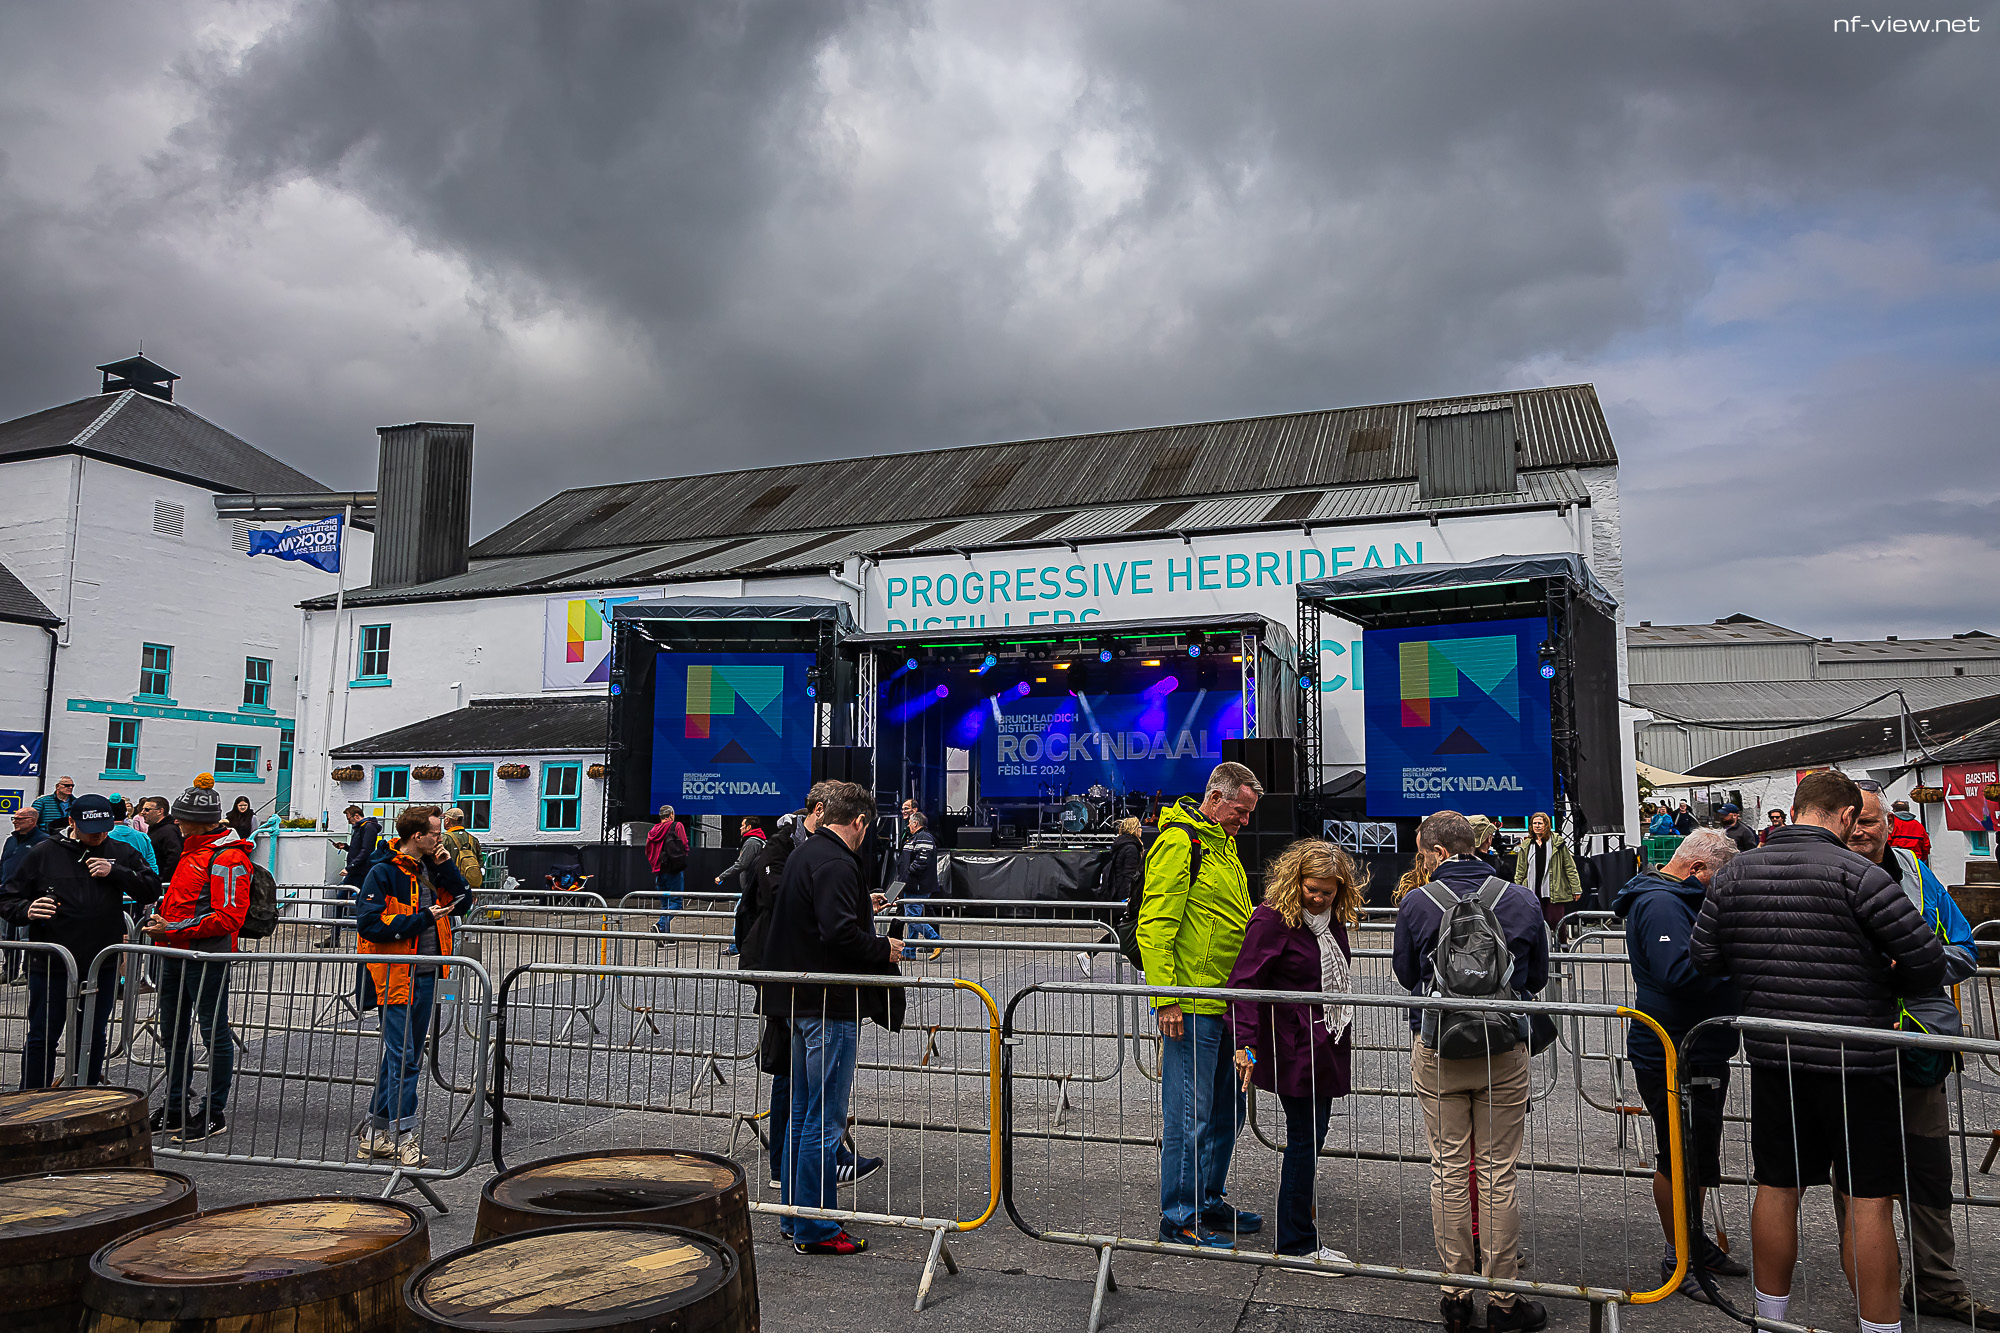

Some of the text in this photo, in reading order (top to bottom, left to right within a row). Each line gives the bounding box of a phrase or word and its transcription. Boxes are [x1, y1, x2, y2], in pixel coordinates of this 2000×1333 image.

[887, 541, 1423, 609] PROGRESSIVE HEBRIDEAN
[998, 713, 1079, 724] BRUICHLADDICH
[998, 723, 1053, 733] DISTILLERY
[1040, 765, 1066, 775] 2024
[1965, 771, 1997, 785] BARS THIS
[1964, 786, 1979, 797] WAY
